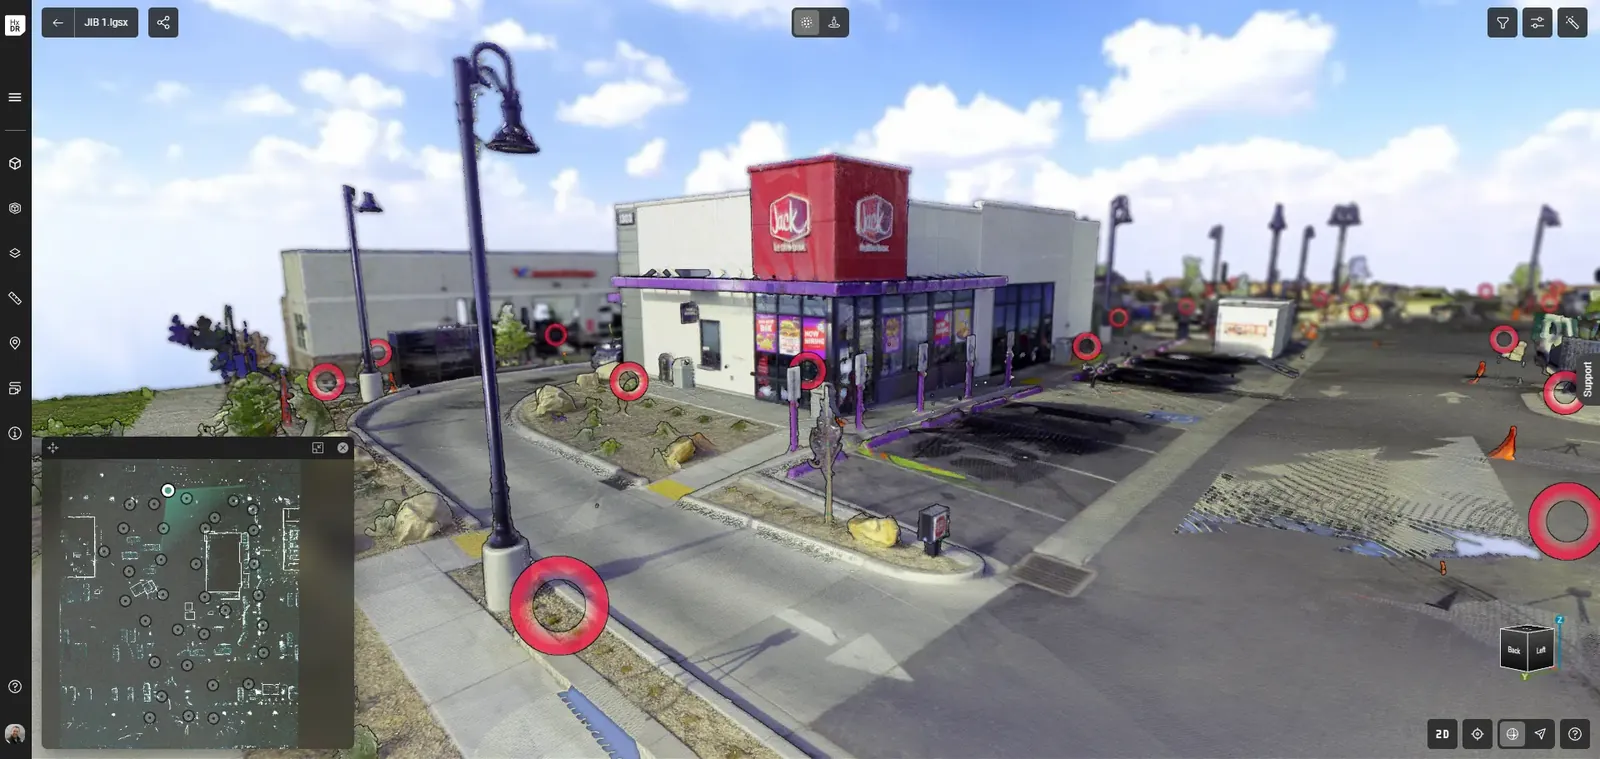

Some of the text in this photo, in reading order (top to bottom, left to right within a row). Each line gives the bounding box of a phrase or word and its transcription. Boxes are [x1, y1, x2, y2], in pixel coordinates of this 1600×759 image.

[773, 199, 808, 234] Jack
[862, 200, 891, 233] Jack
[804, 330, 820, 338] NOW
